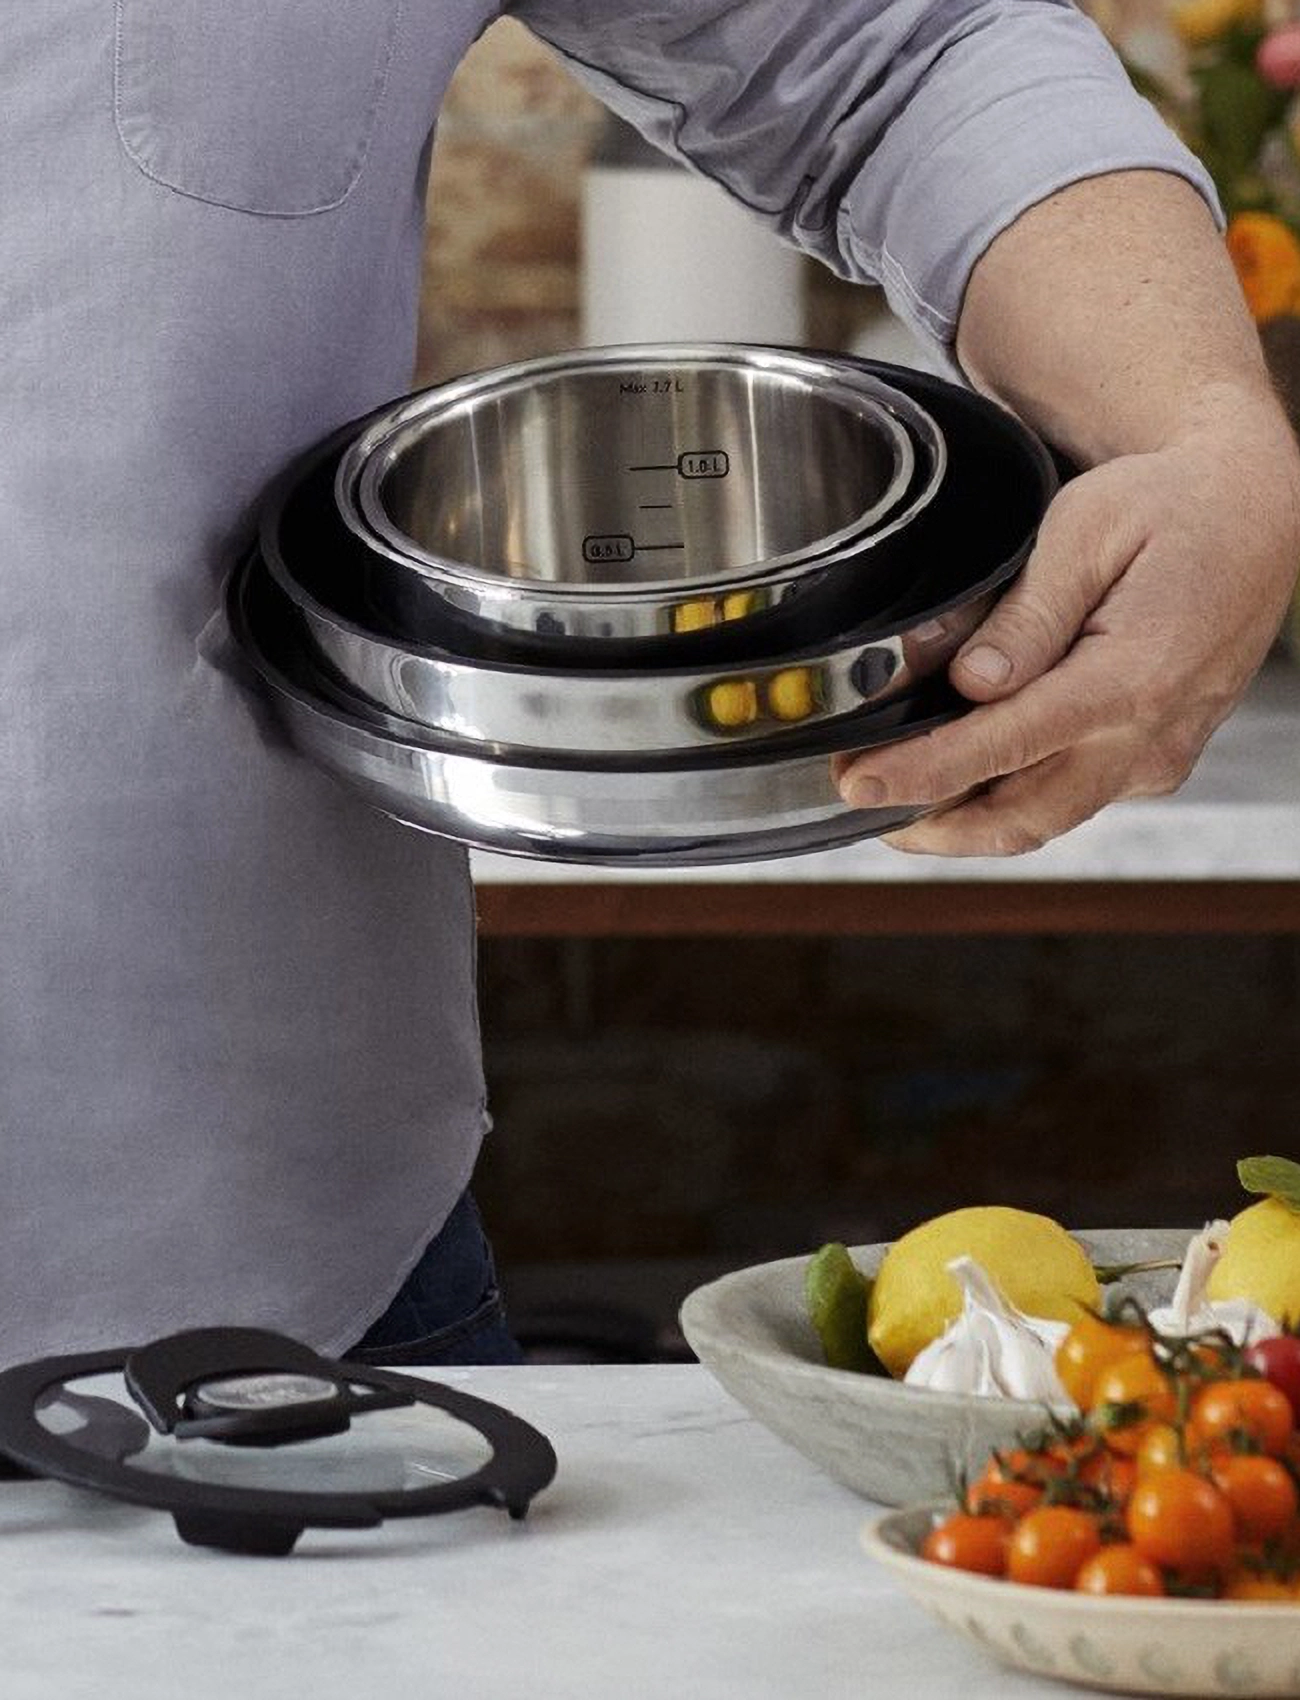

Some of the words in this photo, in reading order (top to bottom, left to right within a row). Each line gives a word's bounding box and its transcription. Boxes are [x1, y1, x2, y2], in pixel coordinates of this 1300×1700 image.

[619, 382, 647, 395] Max
[653, 380, 672, 393] 1.7
[675, 380, 684, 392] L
